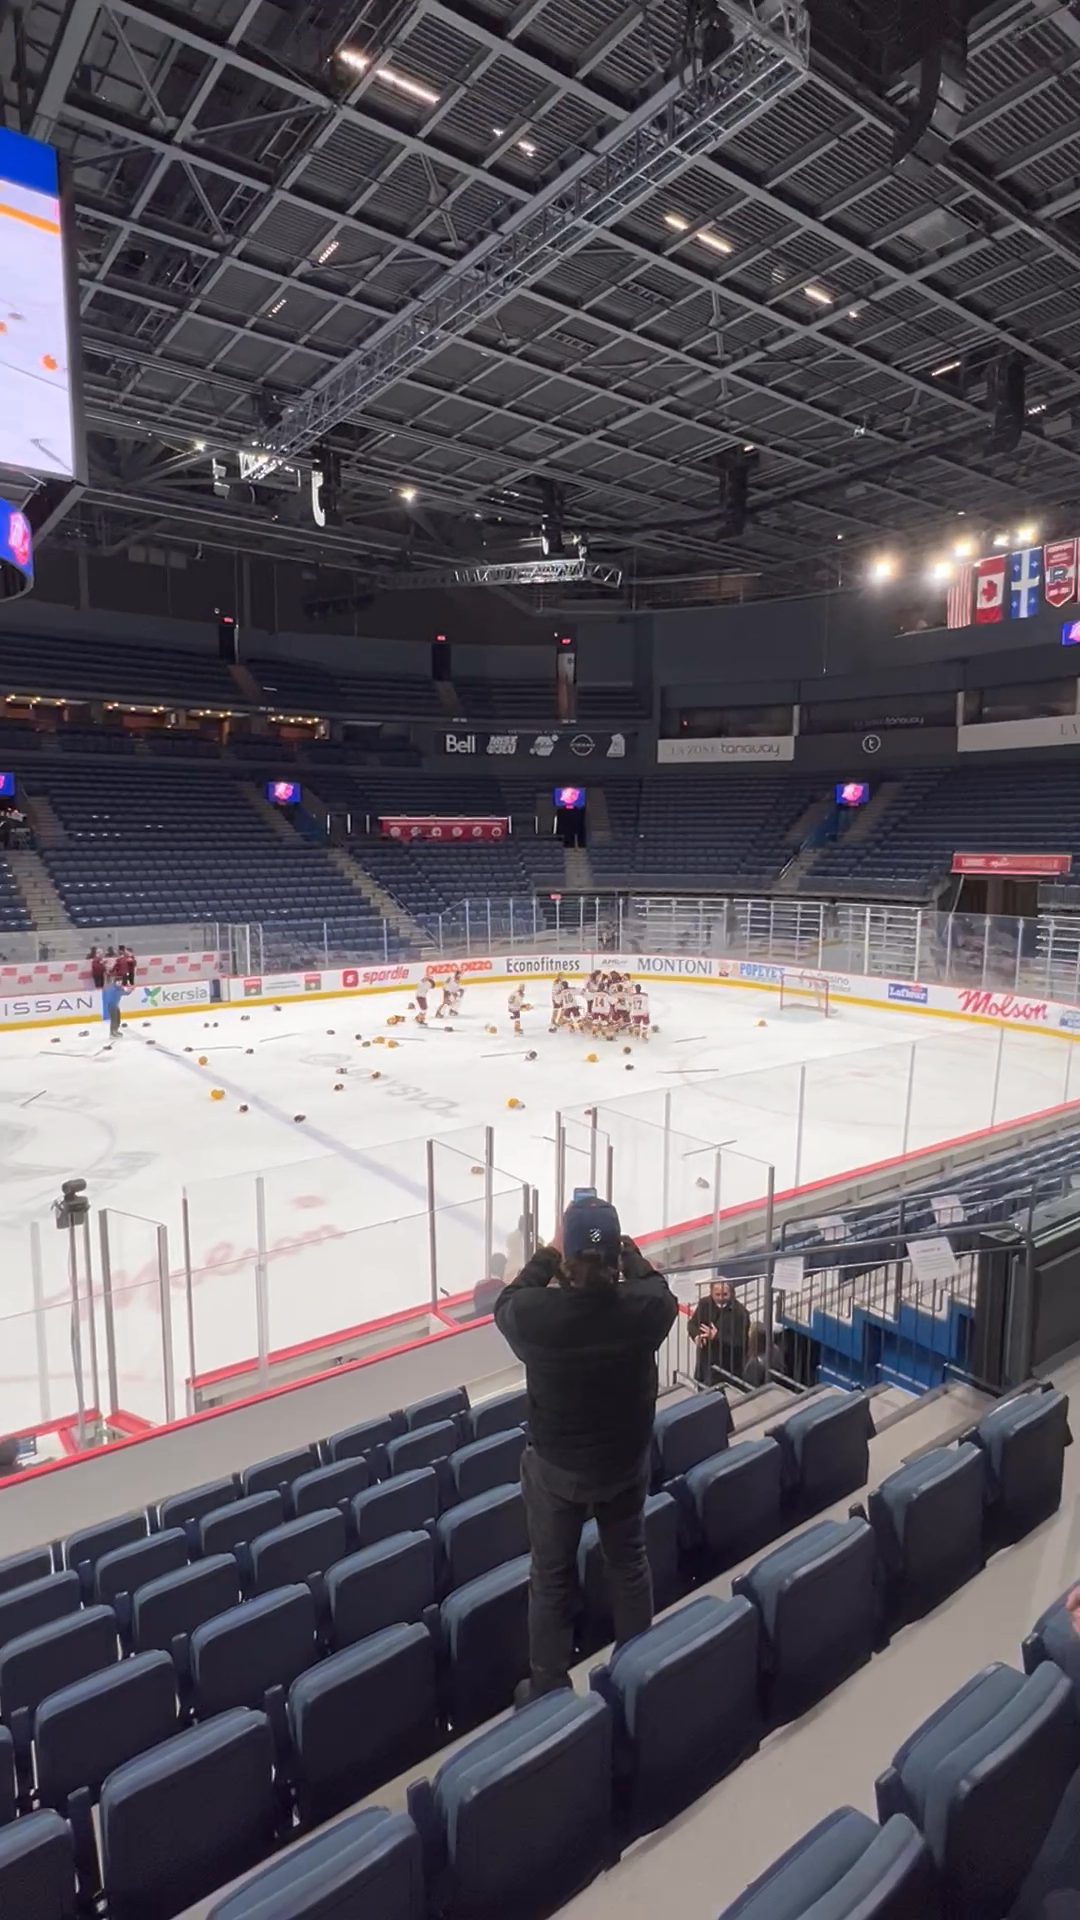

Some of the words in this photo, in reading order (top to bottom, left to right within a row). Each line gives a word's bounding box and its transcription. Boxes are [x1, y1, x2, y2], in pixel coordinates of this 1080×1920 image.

[446, 734, 476, 753] Bell
[506, 957, 580, 973] Econofitness
[637, 957, 713, 975] MONTONI
[362, 967, 409, 984] spordle
[162, 987, 208, 1002] kersia
[958, 990, 1048, 1020] Molson
